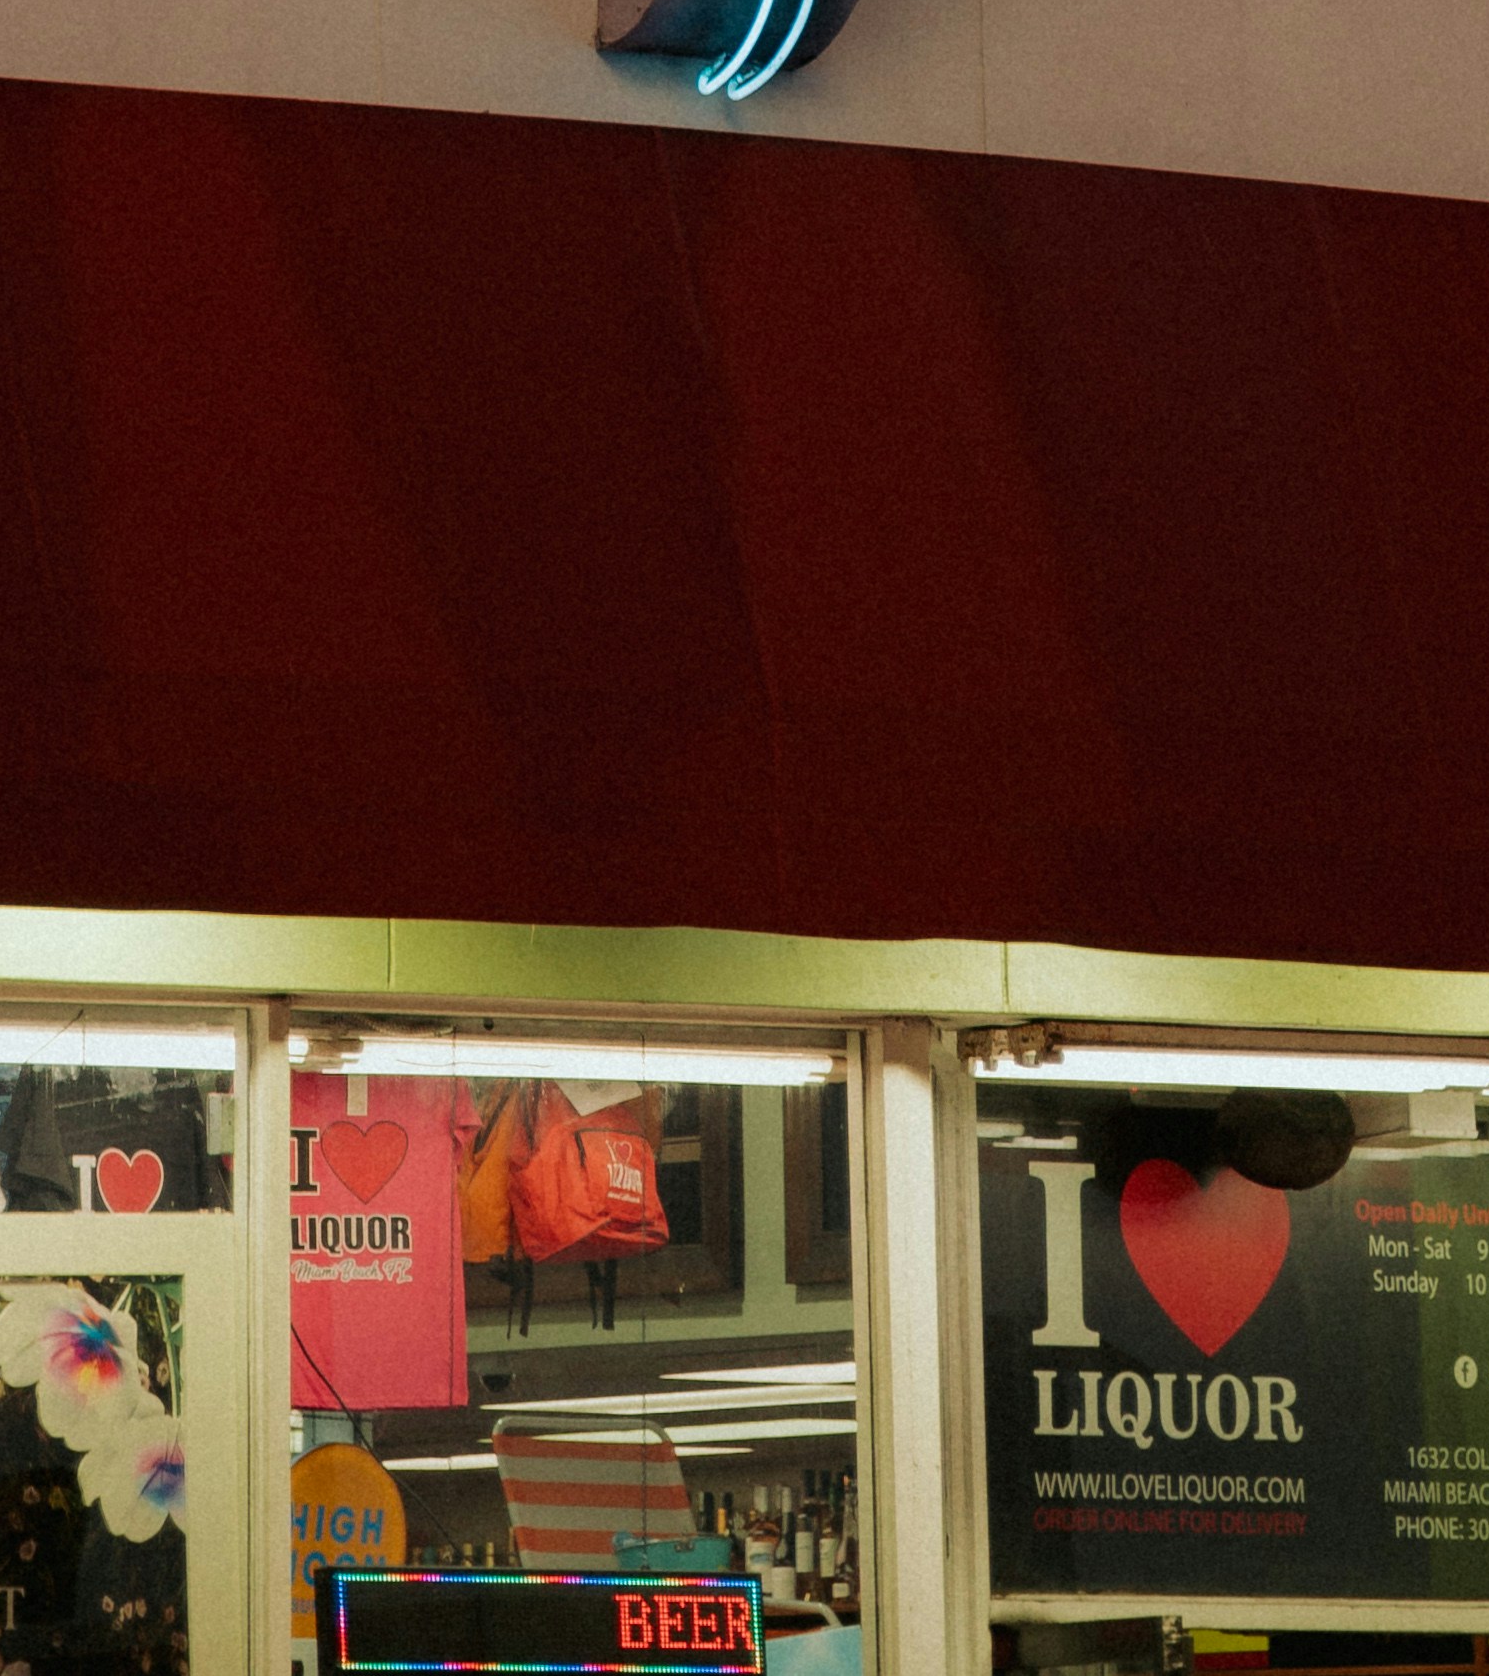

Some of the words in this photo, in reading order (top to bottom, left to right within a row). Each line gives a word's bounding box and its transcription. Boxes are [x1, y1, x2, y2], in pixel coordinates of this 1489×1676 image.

[290, 1127, 320, 1196] I
[1354, 1199, 1407, 1228] Open
[1411, 1200, 1460, 1230] Daily
[291, 1213, 412, 1255] LIQUOR
[1368, 1234, 1409, 1258] Mon
[1424, 1236, 1452, 1260] Sat
[1477, 1239, 1488, 1262] 9
[1028, 1161, 1100, 1347] I
[292, 1258, 339, 1283] Miami
[1373, 1268, 1439, 1299] Sunday
[1466, 1273, 1487, 1296] 10
[1033, 1370, 1304, 1450] LIQUOR
[1408, 1447, 1450, 1469] 1632
[1034, 1471, 1306, 1504] WWW.ILOVELIQUOR.COM
[1384, 1480, 1441, 1504] MIAMI
[290, 1501, 385, 1545] HIGH
[1033, 1505, 1100, 1533] ORDER
[1103, 1507, 1175, 1534] ONLINE
[1179, 1509, 1218, 1534] FOR
[1220, 1511, 1308, 1536] DELIVERY
[1395, 1516, 1464, 1540] PHONE:
[614, 1593, 756, 1650] BEER
